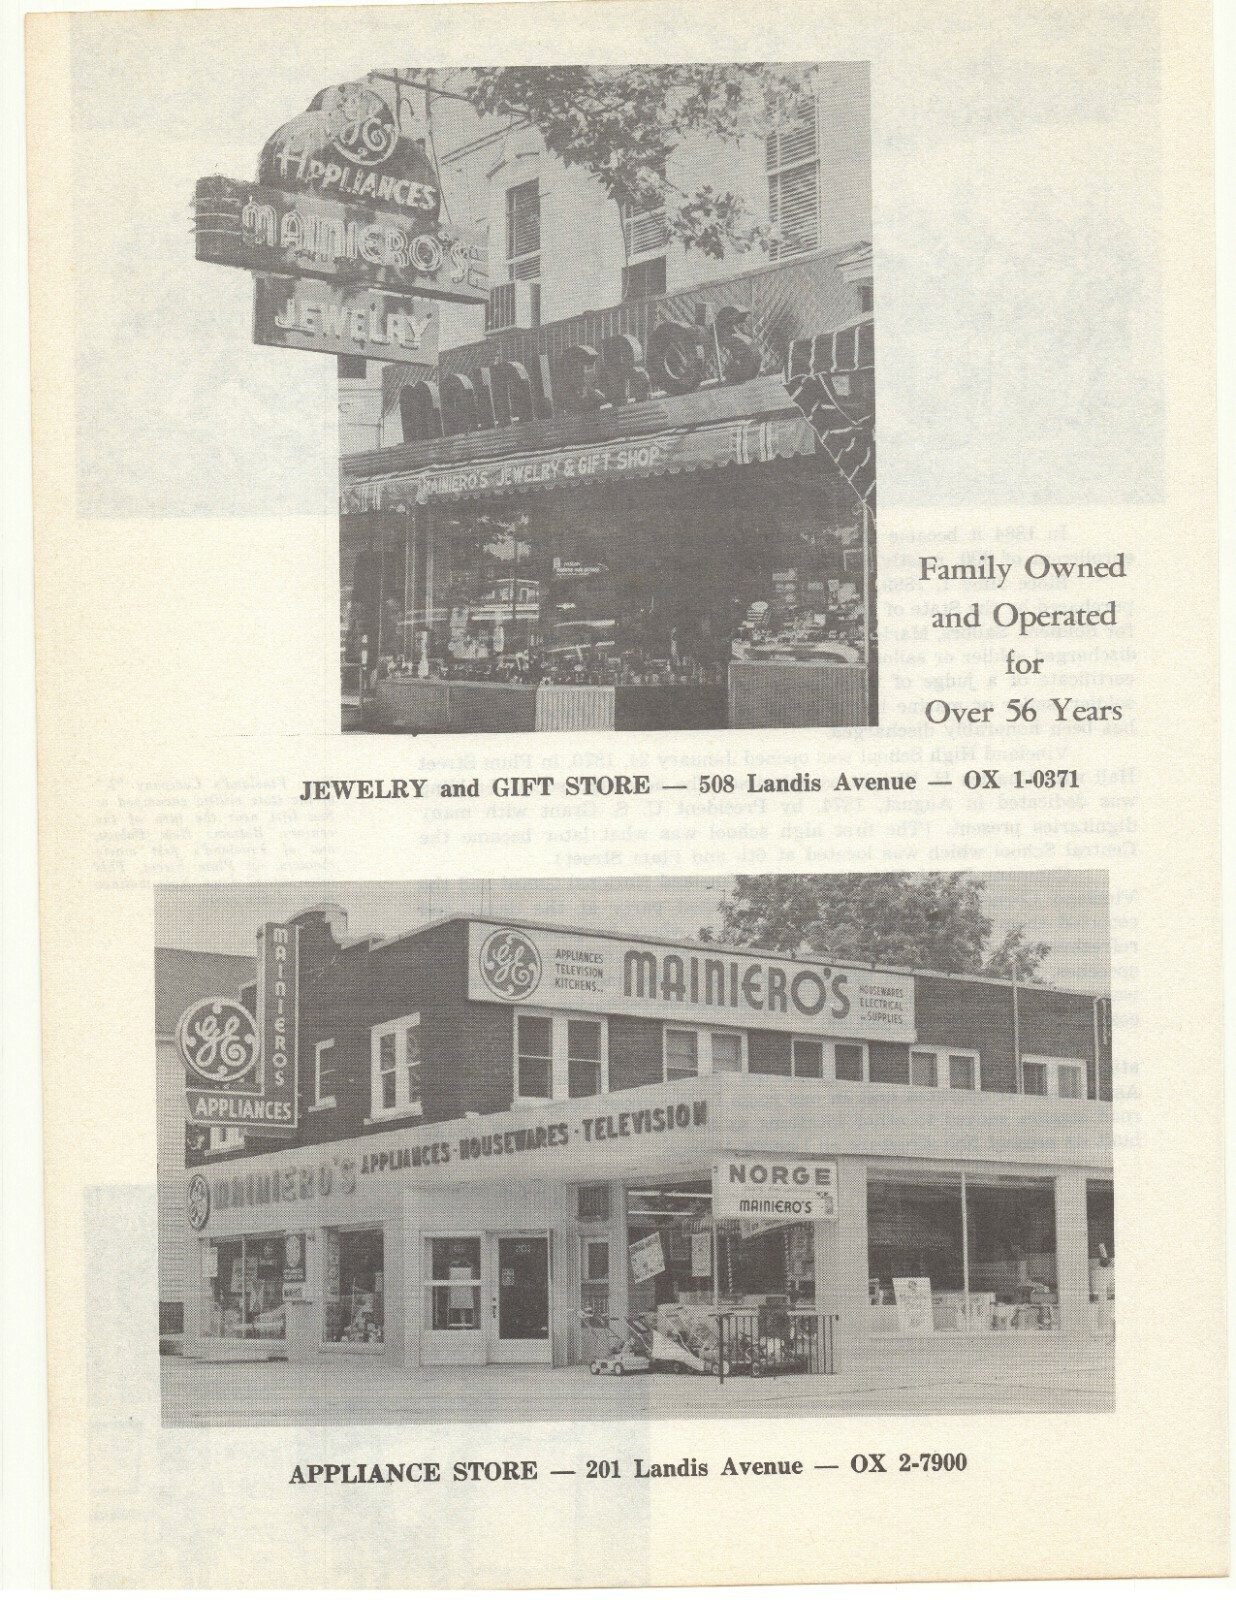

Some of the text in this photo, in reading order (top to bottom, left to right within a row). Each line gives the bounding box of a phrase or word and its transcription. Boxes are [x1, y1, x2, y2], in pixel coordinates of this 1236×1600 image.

[276, 138, 438, 211] APPLIANCES
[497, 462, 559, 486] JEWELRY
[563, 457, 576, 478] &
[578, 452, 610, 475] GIFT
[616, 447, 661, 471] SHOP
[918, 555, 1012, 588] Family
[1024, 553, 1127, 579] Owned
[932, 602, 981, 628] and
[993, 601, 1117, 635] Operated
[1005, 649, 1044, 675] for
[925, 699, 994, 724] Over
[1006, 698, 1037, 722] 56
[1050, 698, 1122, 722] Years
[299, 779, 428, 801] JEWELRY
[440, 778, 480, 798] and
[492, 776, 555, 797] GIFT
[565, 775, 651, 796] STORE
[699, 774, 735, 794] 508
[746, 772, 822, 793] Landis
[833, 772, 917, 791] Avenue
[963, 769, 1001, 790] OX
[1013, 769, 1080, 789] 1-0371
[554, 962, 604, 979] TELEVISION
[555, 948, 604, 965] APPLIANCES
[622, 949, 851, 1020] MAINIERO'S
[859, 997, 904, 1012] ELECTRICAL
[195, 1097, 292, 1120] APPLIANCES
[361, 1142, 450, 1175] APPLIANCES
[459, 1122, 569, 1161] HOUSEWARES
[582, 1100, 708, 1143] TELEVISION
[728, 1163, 832, 1187] NORGE
[739, 1199, 813, 1214] MAINIERO'S
[288, 1462, 441, 1485] APPLIANCE
[453, 1460, 538, 1481] STORE
[585, 1459, 622, 1479] 201
[633, 1457, 709, 1478] Landis
[720, 1456, 804, 1476] Avenue
[850, 1453, 888, 1474] OX
[898, 1452, 968, 1472] 2-7900
